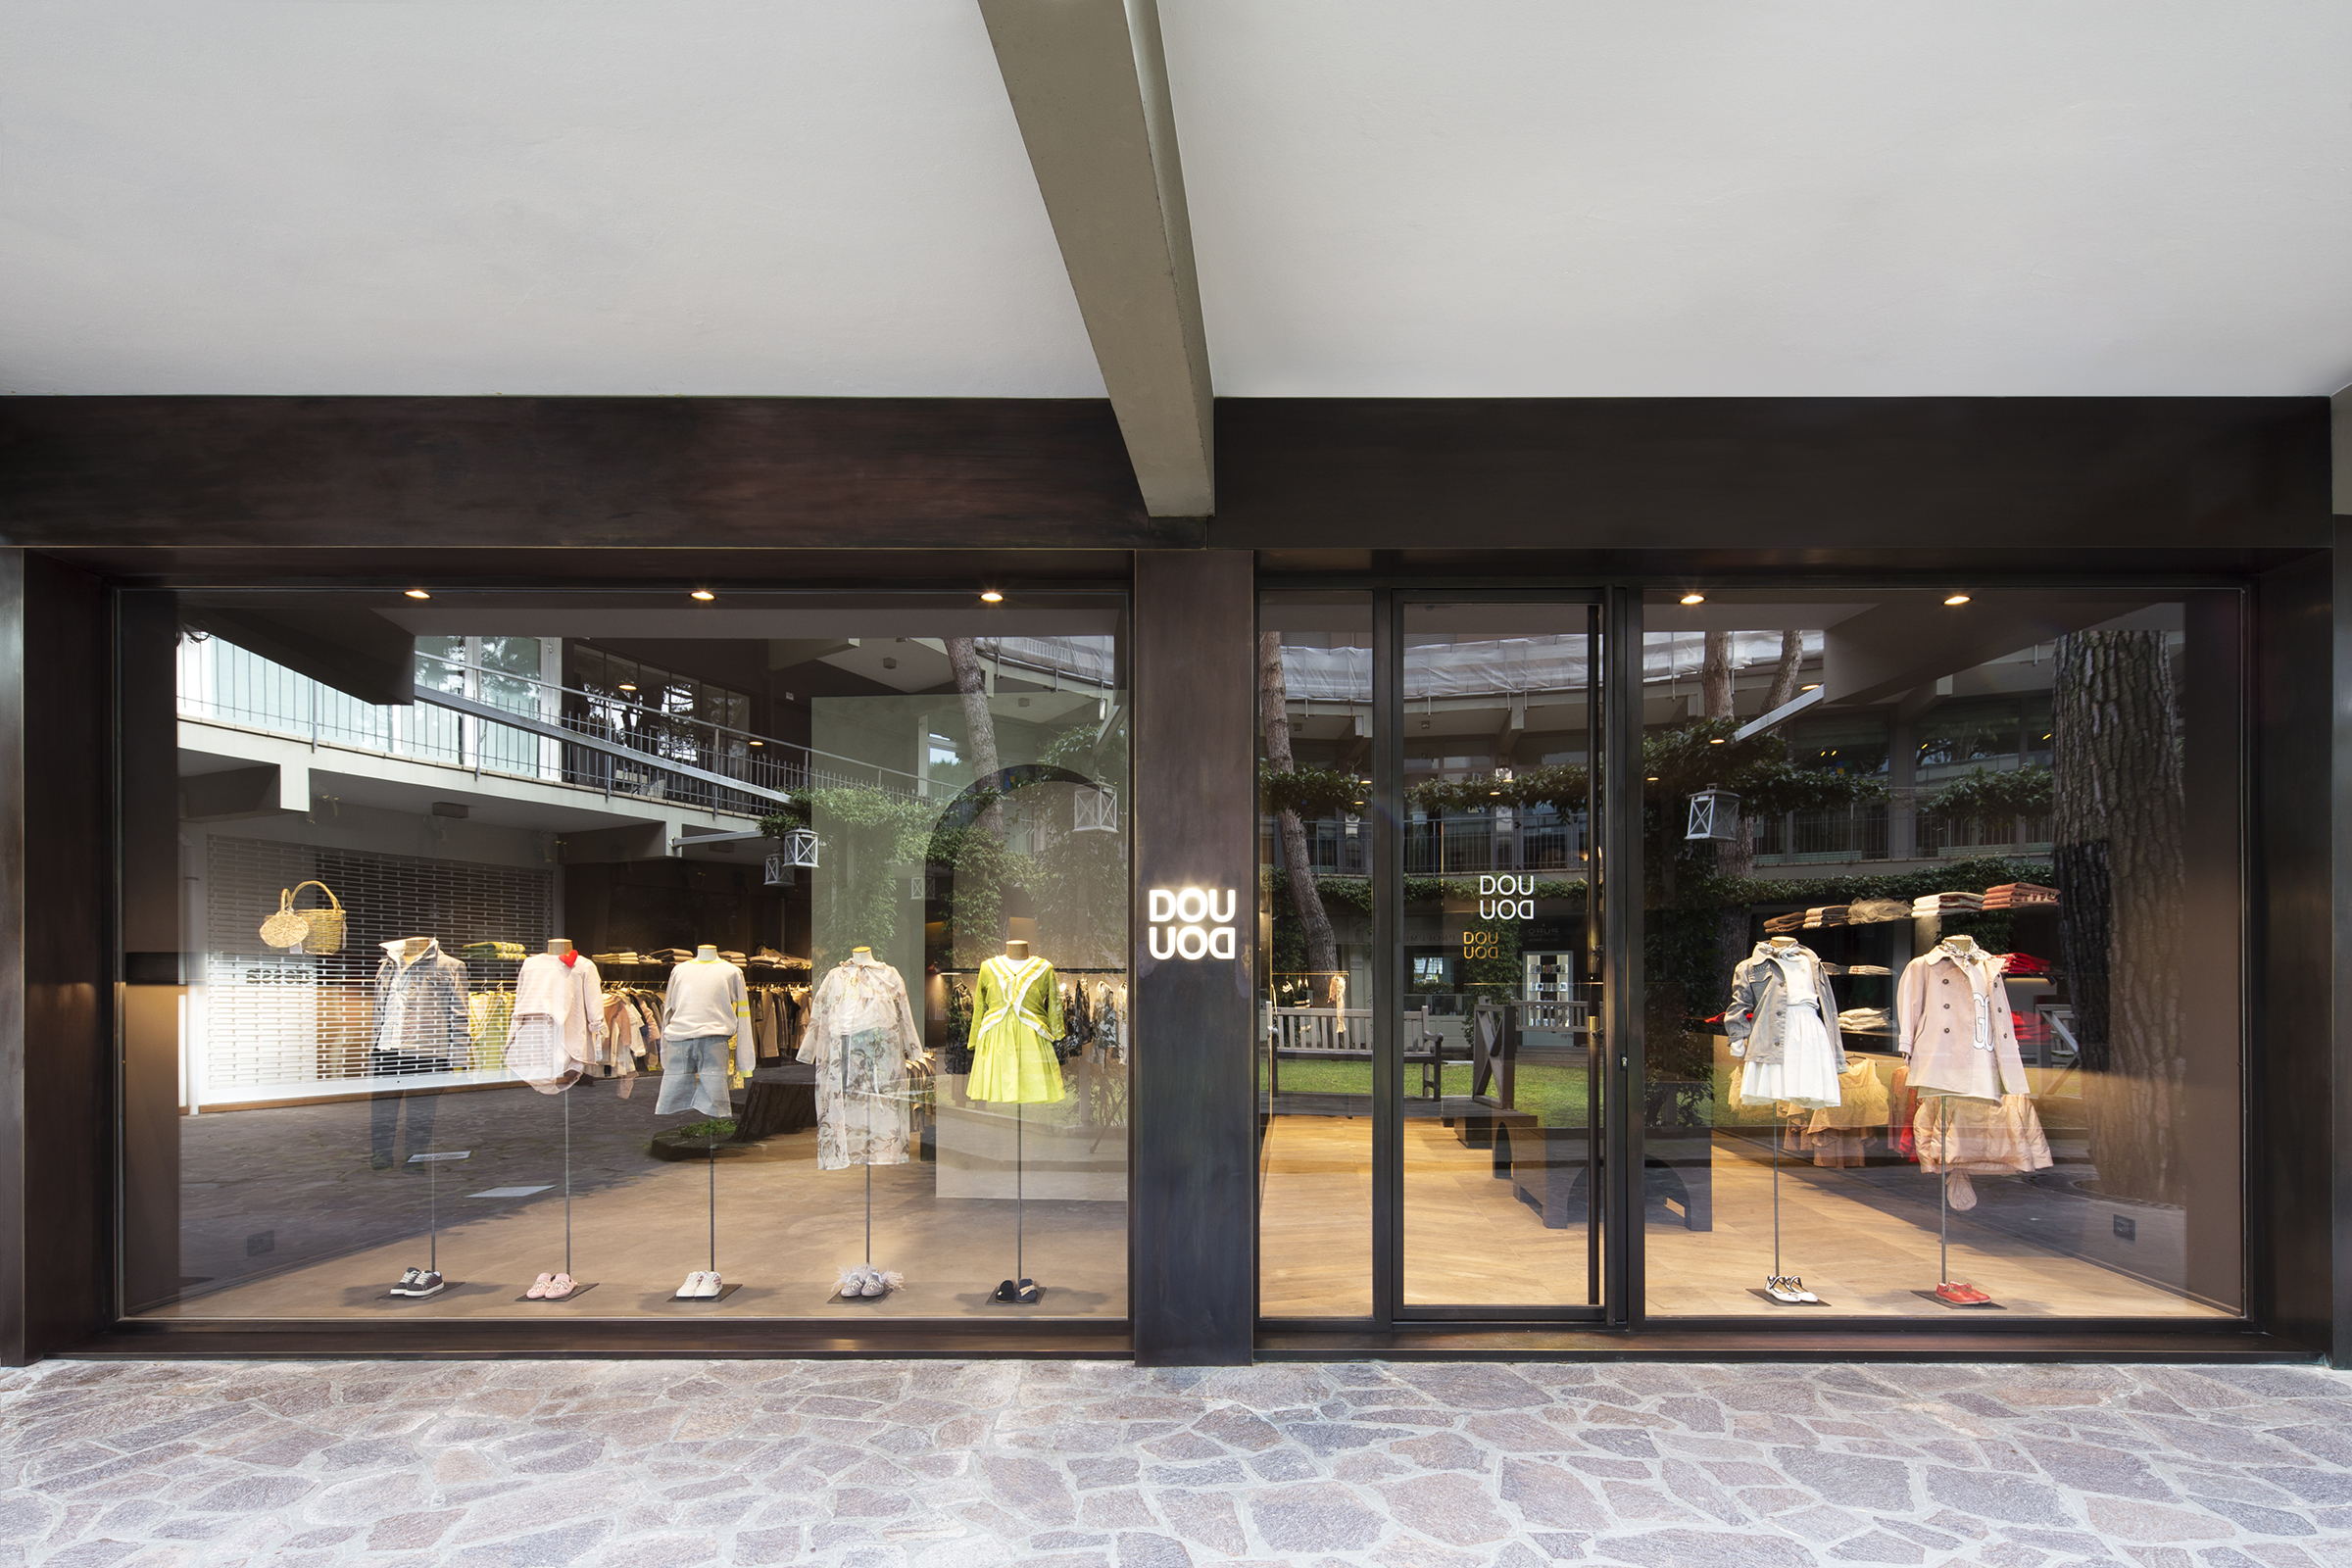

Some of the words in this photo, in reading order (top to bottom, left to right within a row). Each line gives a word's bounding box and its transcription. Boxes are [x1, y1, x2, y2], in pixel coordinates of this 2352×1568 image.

[1479, 874, 1535, 896] DOU
[1148, 887, 1237, 922] DOU
[1462, 931, 1499, 945] DOU
